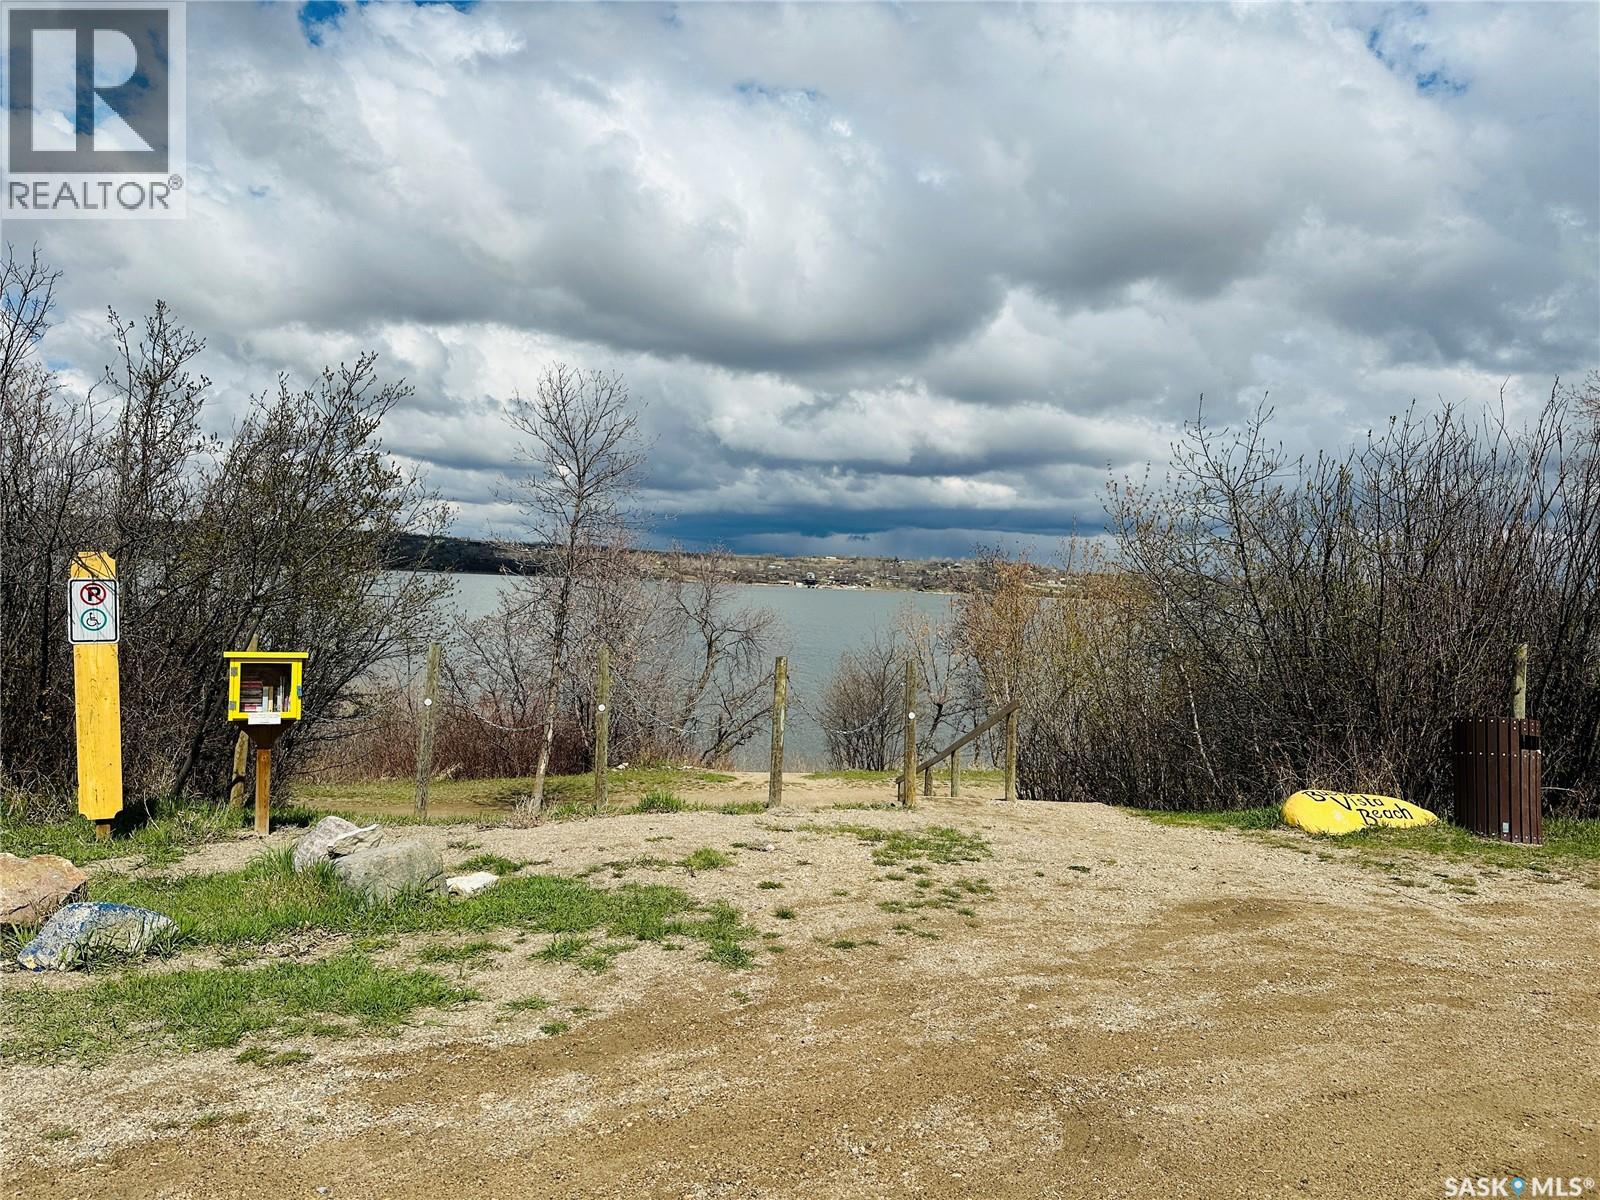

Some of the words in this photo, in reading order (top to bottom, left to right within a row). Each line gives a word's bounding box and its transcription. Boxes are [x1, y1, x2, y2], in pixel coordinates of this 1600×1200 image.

[87, 586, 101, 601] P
[1329, 795, 1384, 811] Vista
[1356, 803, 1413, 826] Beach
